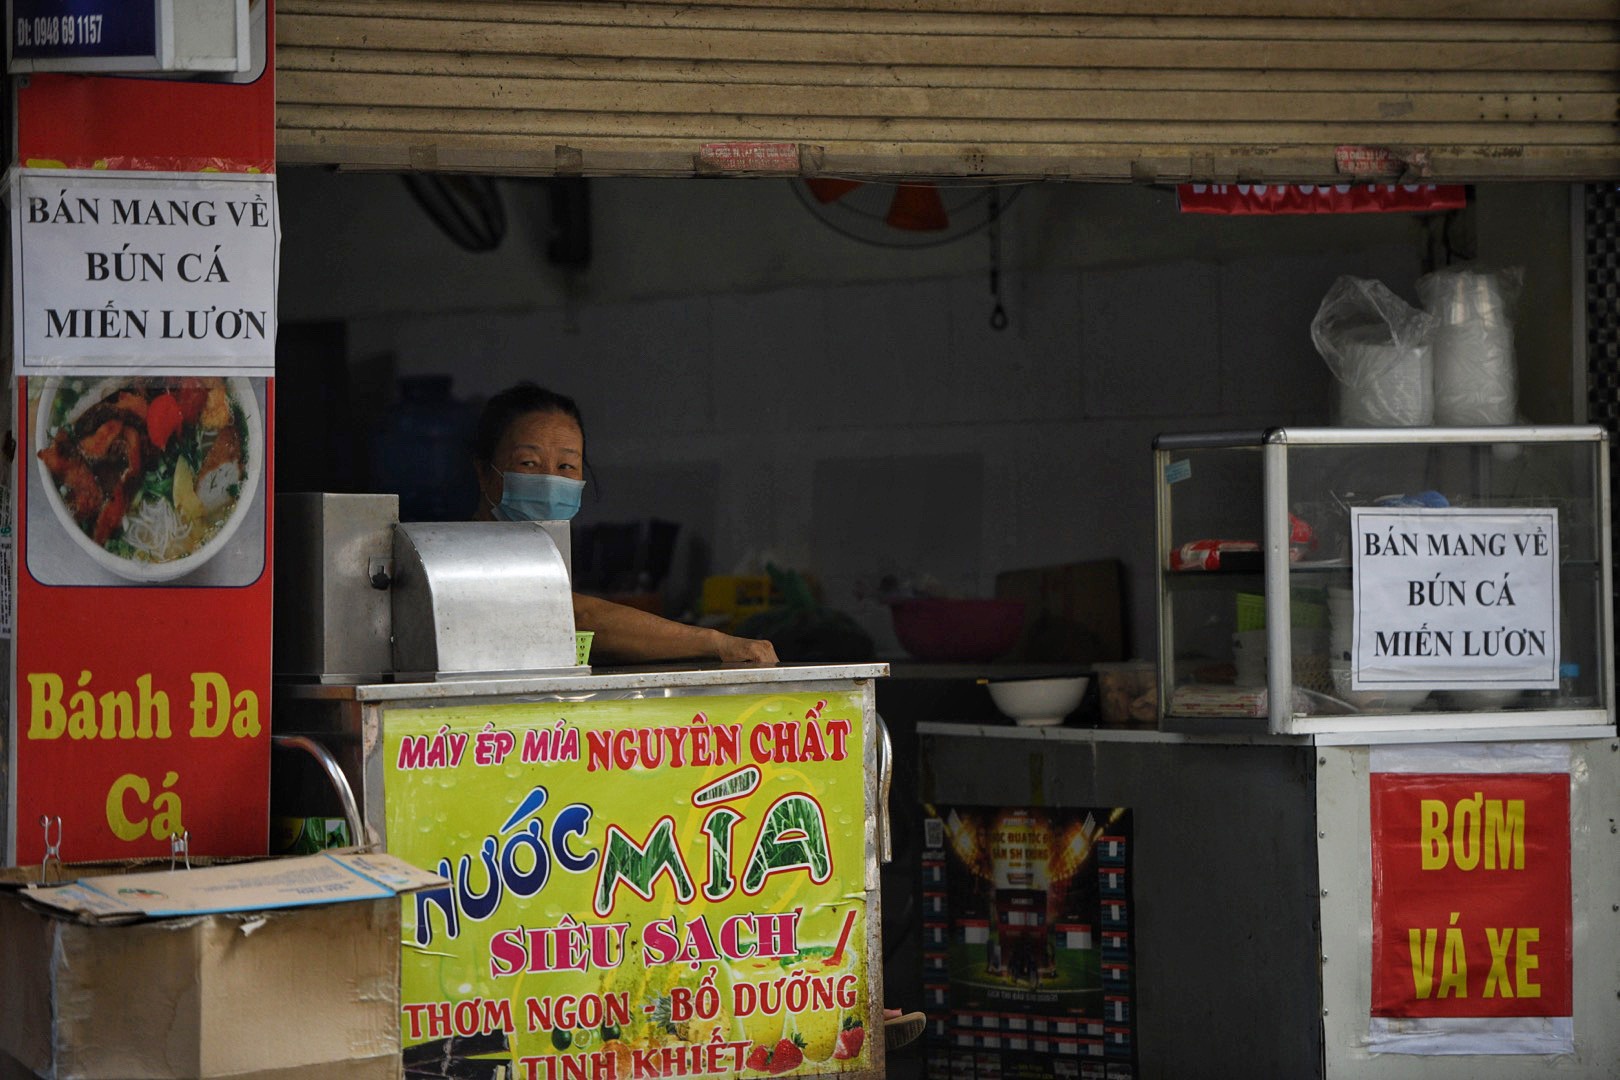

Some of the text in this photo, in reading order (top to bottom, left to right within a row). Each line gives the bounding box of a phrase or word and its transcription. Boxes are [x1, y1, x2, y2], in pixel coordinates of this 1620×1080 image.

[34, 16, 60, 46] 0948
[61, 15, 75, 45] 69
[77, 14, 103, 45] 1157
[27, 189, 270, 228] BÁN MANG VỀ
[84, 243, 231, 284] BÚN CÁ
[44, 300, 267, 340] MIẾN LƯƠN
[1363, 525, 1549, 557] BÁN MANG VỀ
[1407, 572, 1516, 607] BÚN CÁ
[1373, 622, 1547, 657] MIẾN LƯƠN
[27, 669, 262, 740] Bánh Đa
[397, 699, 852, 772] MÁY ÉP MÍA NGUYÊN CHẤT
[105, 771, 186, 842] Cá
[1420, 791, 1526, 872] BƠM
[414, 764, 834, 948] NƯỚC MÍA
[489, 911, 800, 980] SIÊU SẠCH
[1408, 912, 1542, 999] VÁ XE
[402, 997, 515, 1039] THƠM
[526, 991, 632, 1033] NGON
[669, 966, 720, 1023] BỔ
[732, 969, 859, 1018] DƯỠNG
[519, 1026, 754, 1080] TINH KHIẾT
